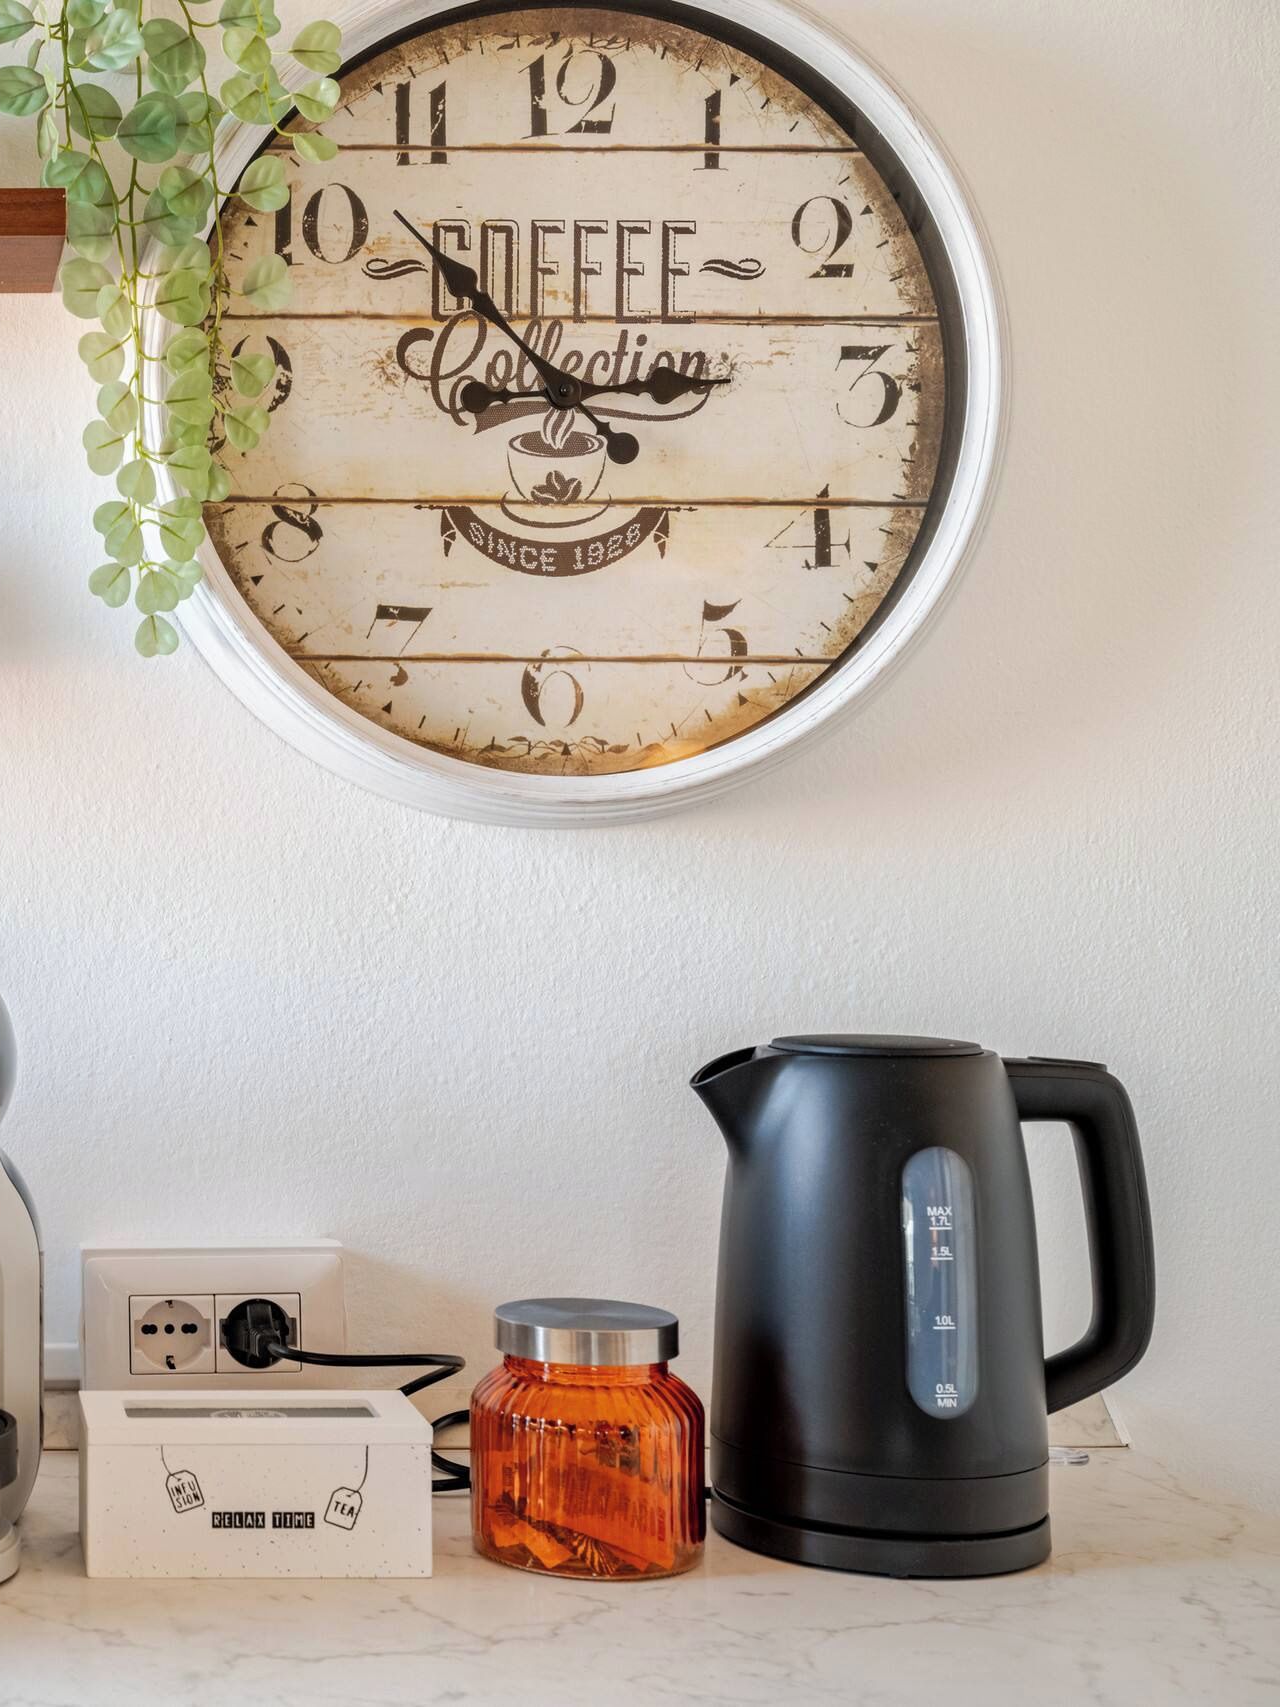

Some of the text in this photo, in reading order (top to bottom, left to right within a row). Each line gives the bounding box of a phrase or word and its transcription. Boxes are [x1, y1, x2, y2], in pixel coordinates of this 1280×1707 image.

[394, 80, 451, 167] 11
[518, 49, 617, 140] 12
[693, 88, 728, 172] 1
[273, 181, 369, 266] 10
[791, 195, 855, 279] 2
[431, 218, 697, 325] COFFEE
[396, 311, 710, 426] Collection
[835, 343, 904, 429] 3
[261, 482, 324, 563] 8
[469, 522, 641, 572] SINCE 1928
[763, 483, 852, 570] 4
[366, 603, 434, 688] 7
[682, 598, 751, 687] 5
[520, 644, 592, 728] 6
[926, 1206, 953, 1217] MAX
[930, 1216, 952, 1226] 1.7L
[932, 1246, 953, 1257] 1.5L
[935, 1383, 957, 1394] 0.5L
[937, 1398, 958, 1408] MIN
[212, 1512, 315, 1528] RELAX TIME
[333, 1501, 356, 1518] TEA
